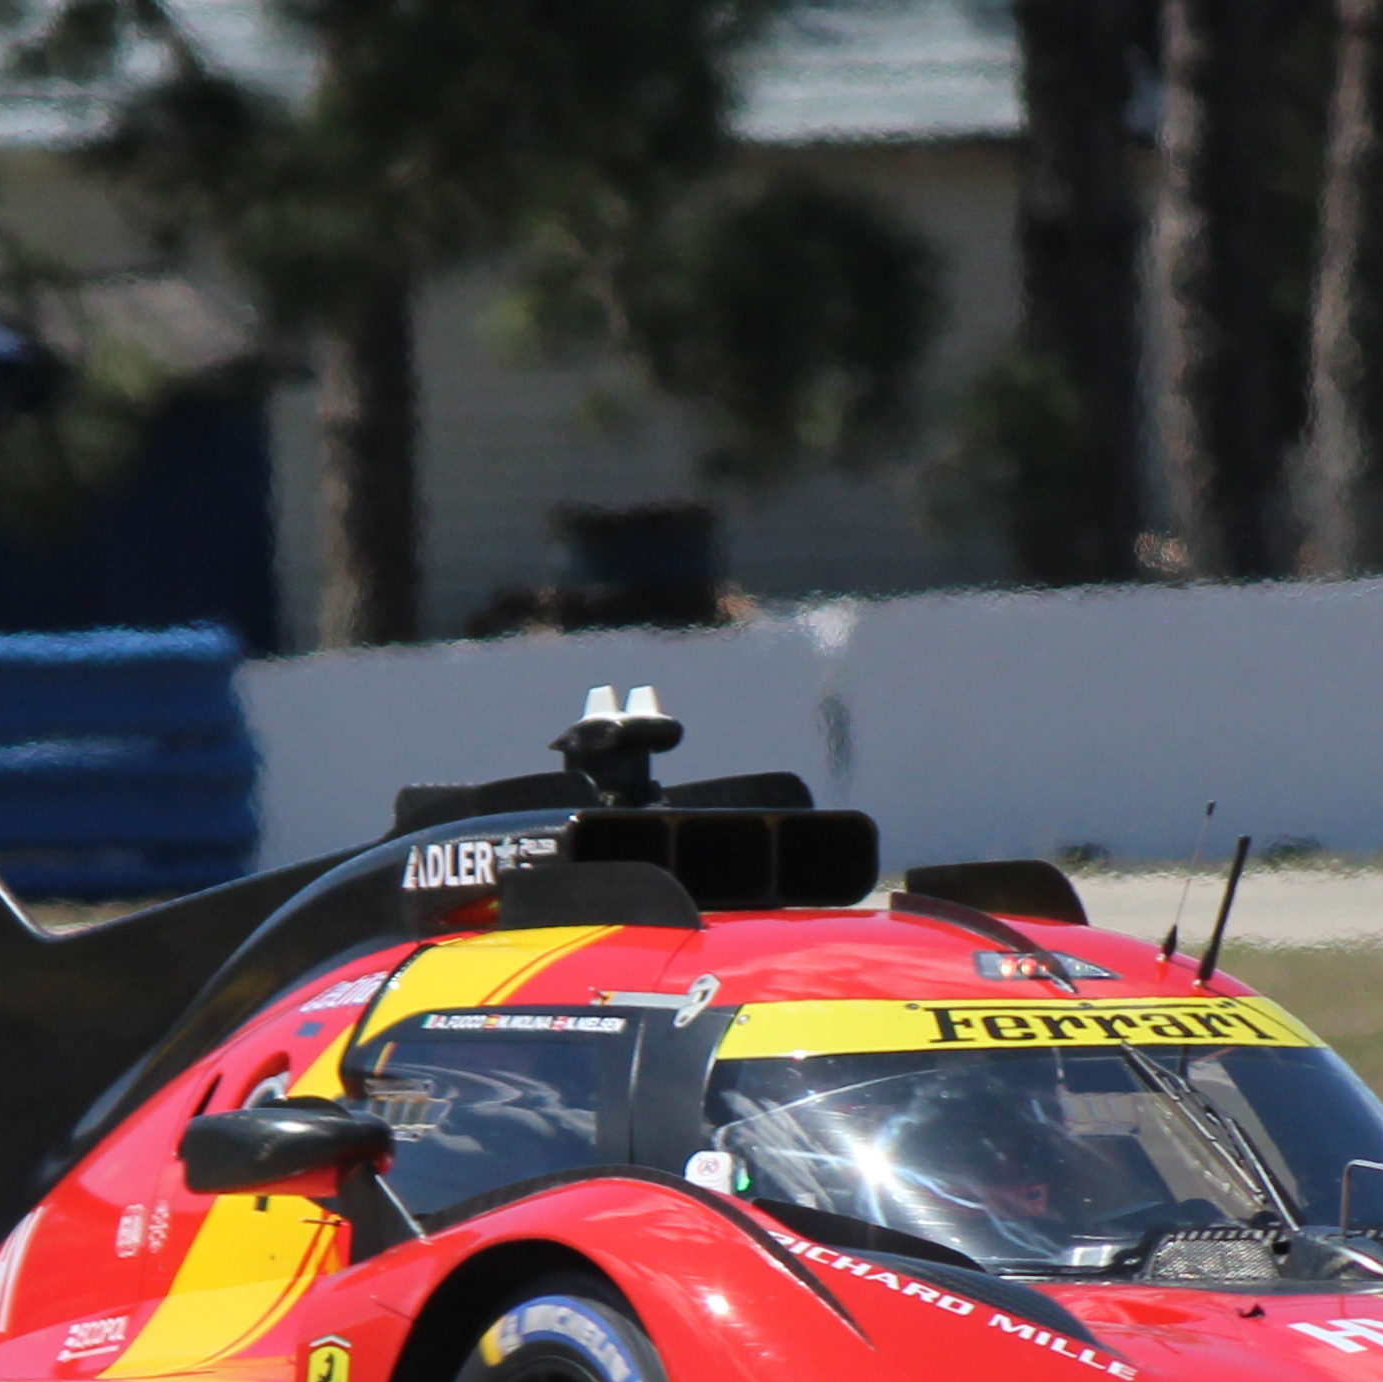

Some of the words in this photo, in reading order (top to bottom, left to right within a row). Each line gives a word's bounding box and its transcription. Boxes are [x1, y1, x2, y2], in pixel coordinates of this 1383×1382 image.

[402, 840, 497, 889] ADLER
[924, 1001, 1278, 1043] Ferrari
[988, 1314, 1140, 1381] MILLE
